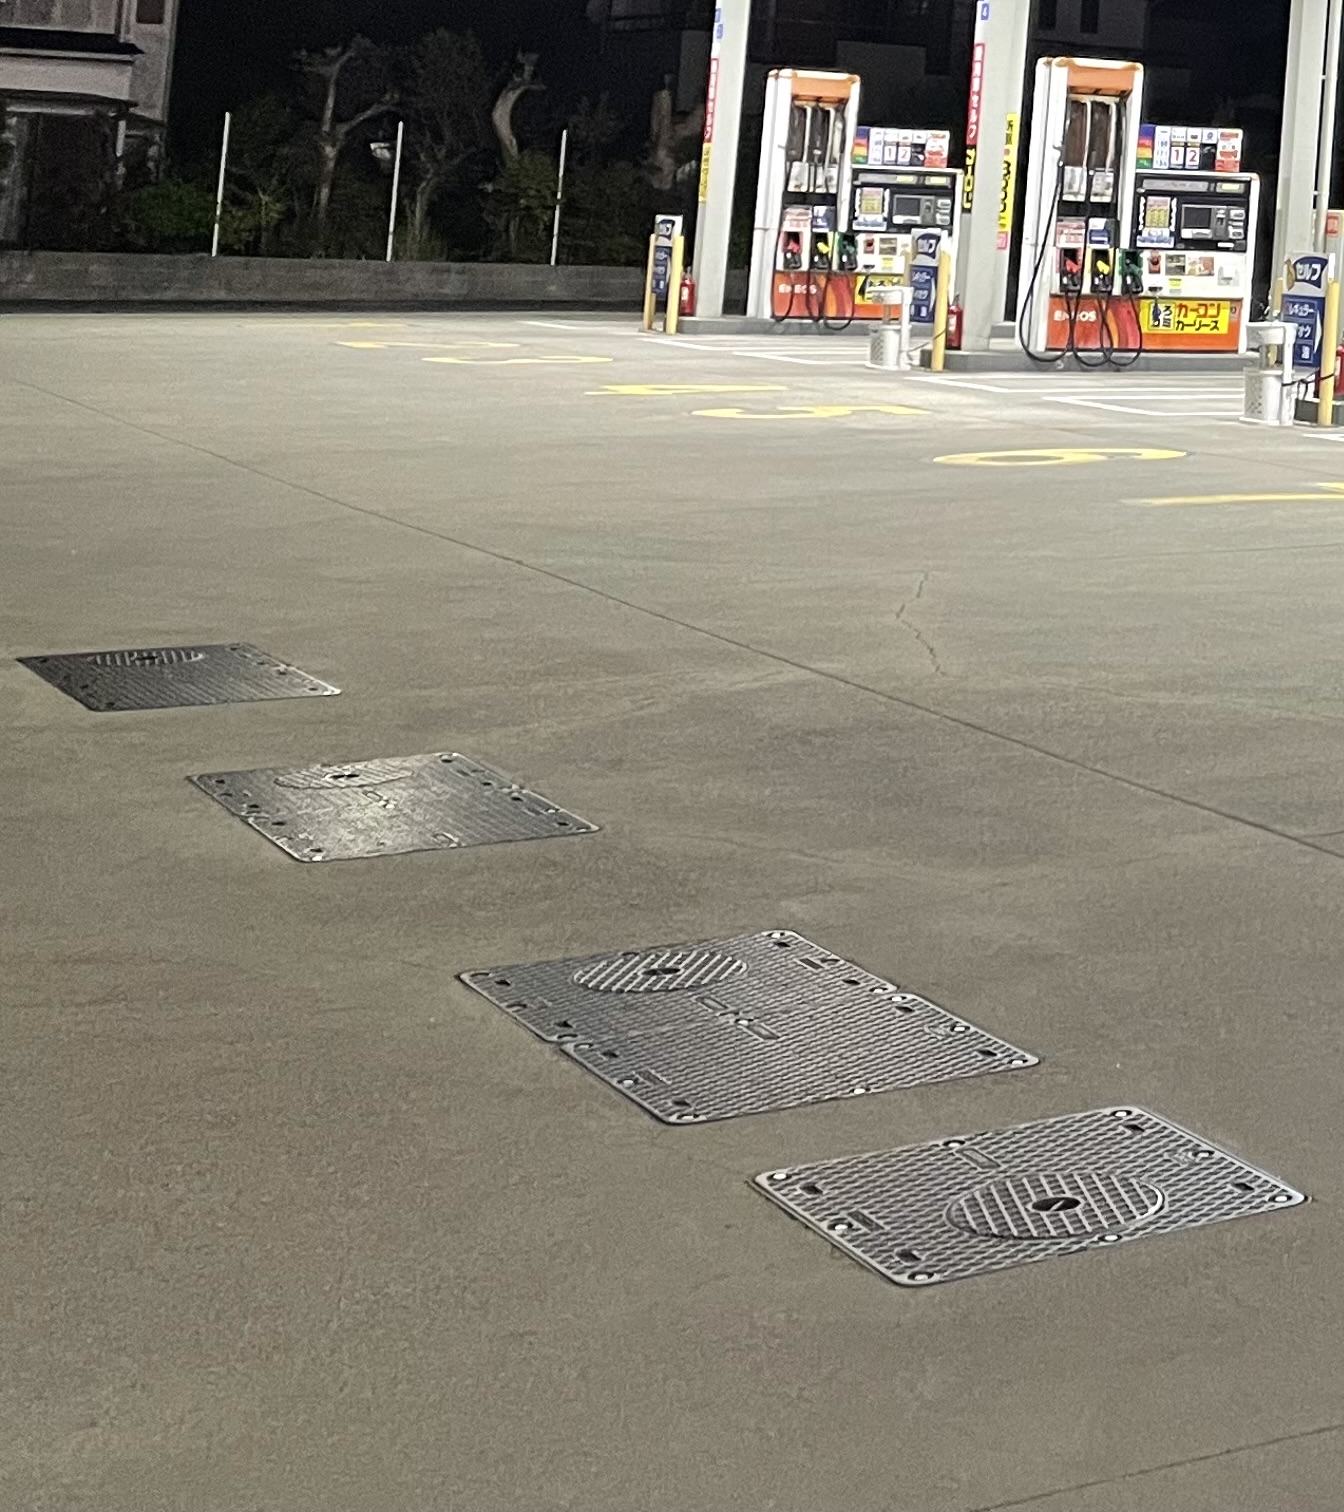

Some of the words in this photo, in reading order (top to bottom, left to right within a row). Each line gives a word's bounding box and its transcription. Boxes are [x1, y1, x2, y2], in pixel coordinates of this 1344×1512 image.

[1296, 263, 1321, 281] セルフ
[1177, 303, 1221, 319] カーコン
[1176, 320, 1220, 332] カーリース
[931, 448, 1190, 466] 6
